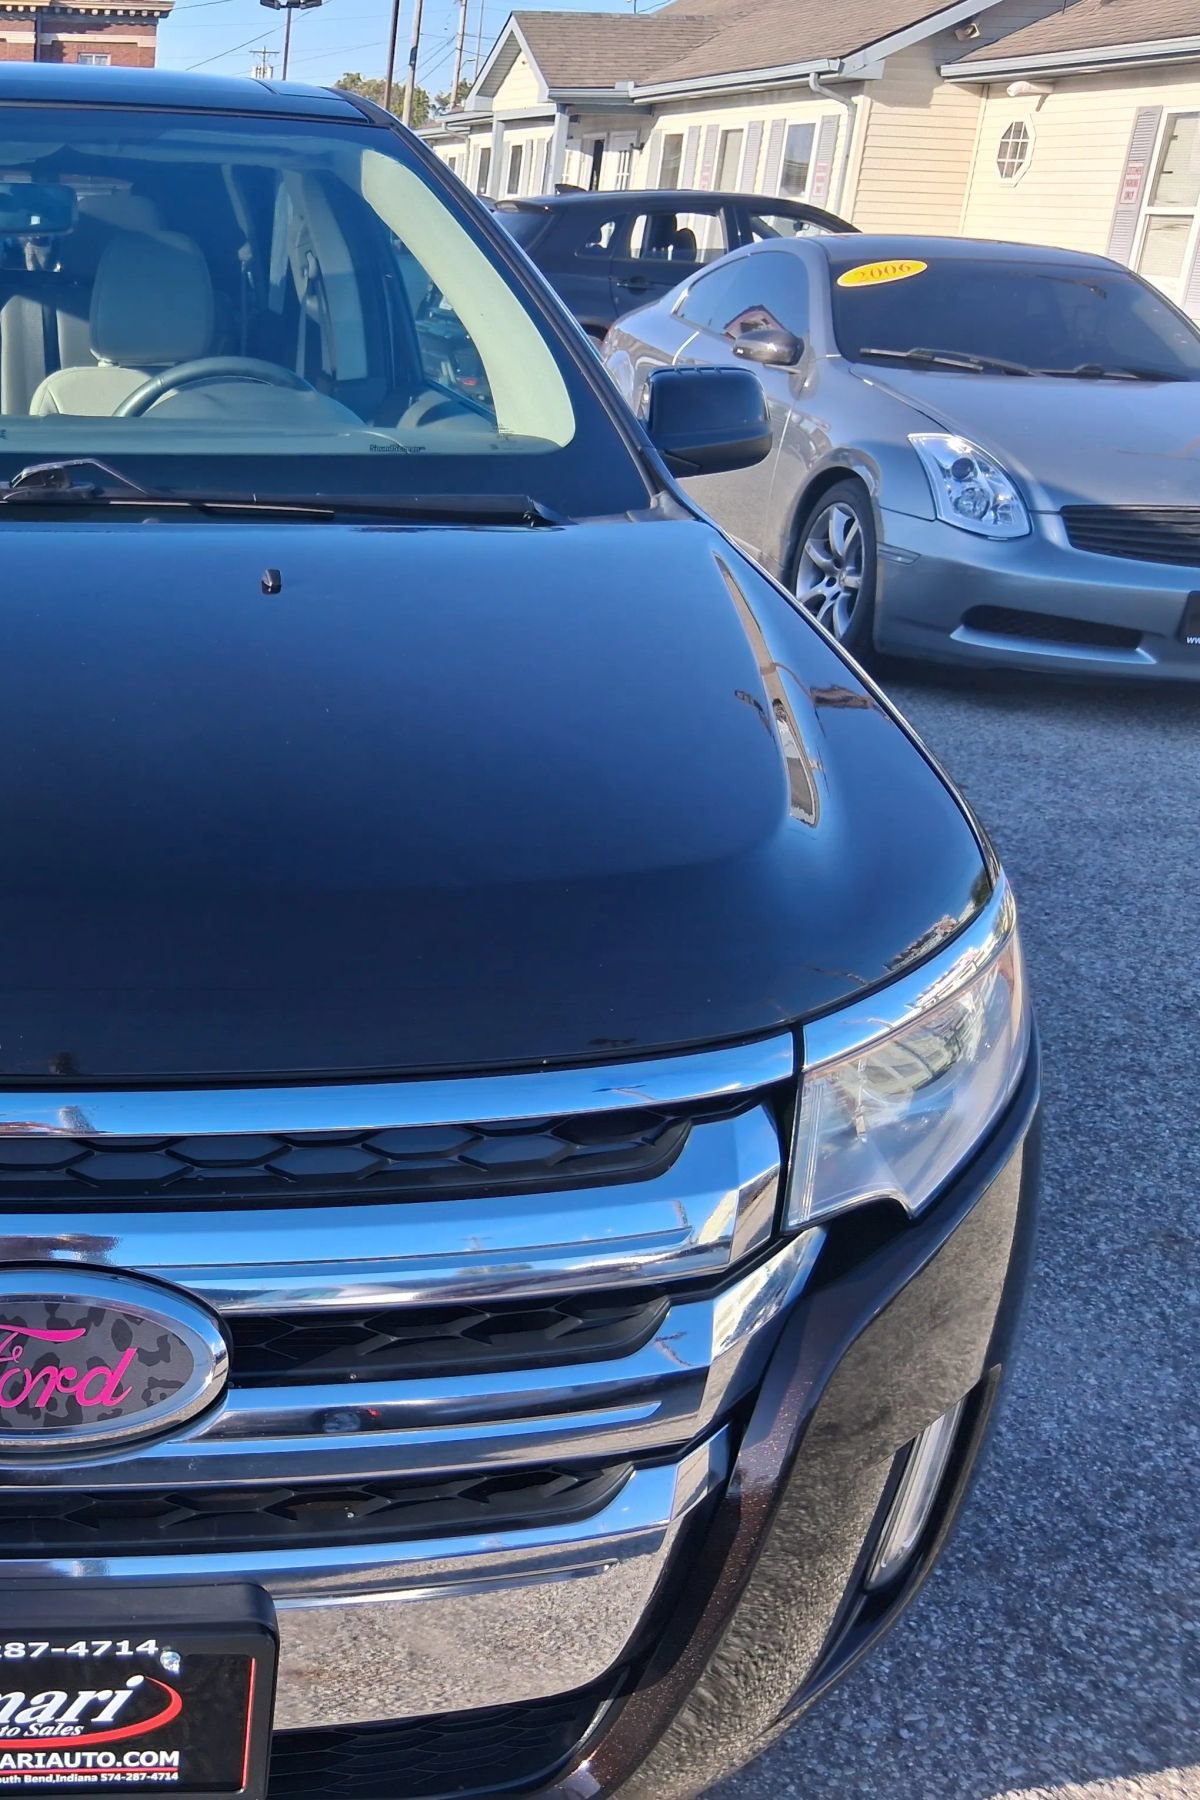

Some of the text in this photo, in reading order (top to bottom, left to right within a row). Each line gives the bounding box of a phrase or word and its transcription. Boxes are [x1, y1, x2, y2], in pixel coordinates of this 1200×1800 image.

[854, 263, 911, 282] 2006
[22, 1722, 84, 1737] Sales
[100, 1772, 179, 1782] 574-287-4714
